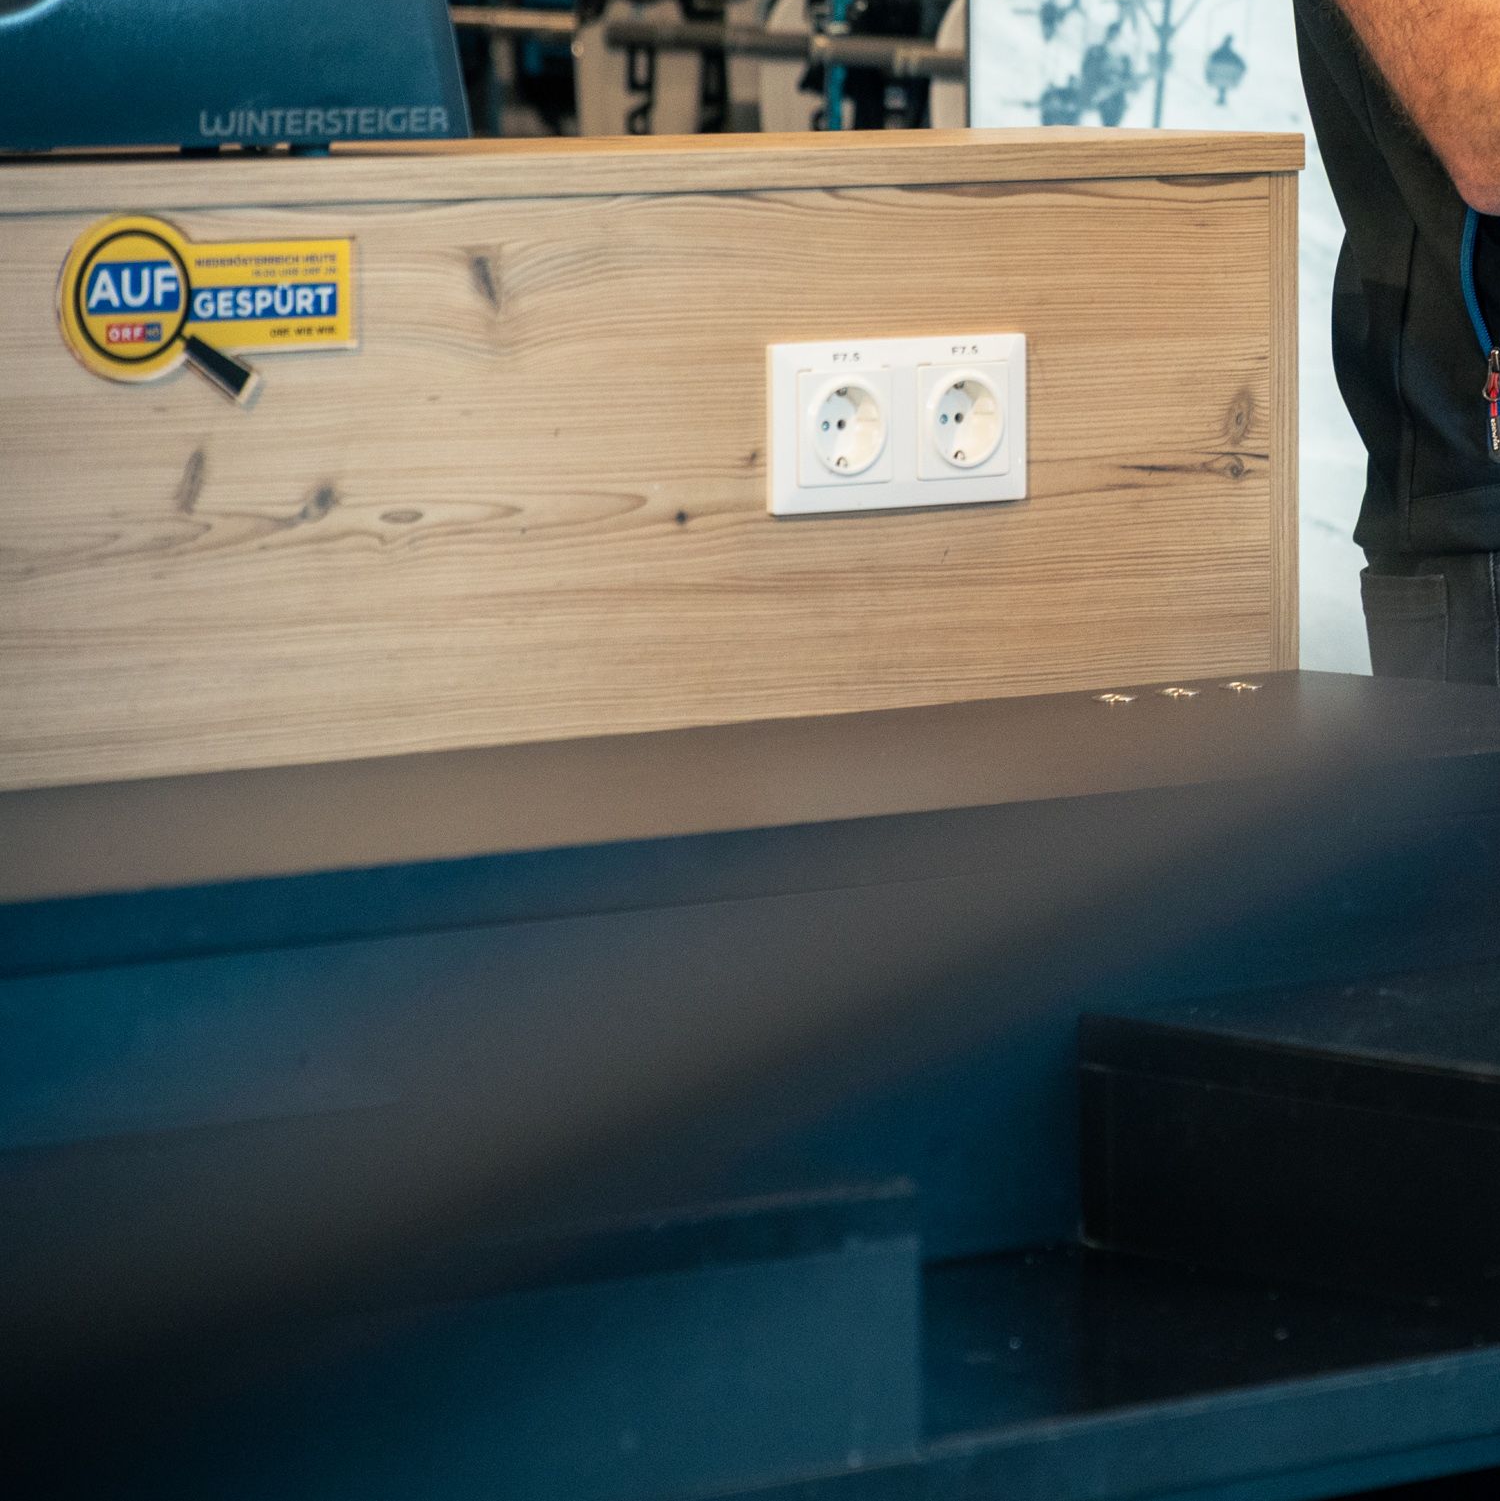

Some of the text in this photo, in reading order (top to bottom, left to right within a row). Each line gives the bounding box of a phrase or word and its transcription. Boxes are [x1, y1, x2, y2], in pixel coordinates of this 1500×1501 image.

[201, 107, 449, 137] WINTERSTEIGER
[88, 267, 178, 308] AUF
[193, 283, 335, 319] GESPÜRT
[108, 326, 144, 342] ORF
